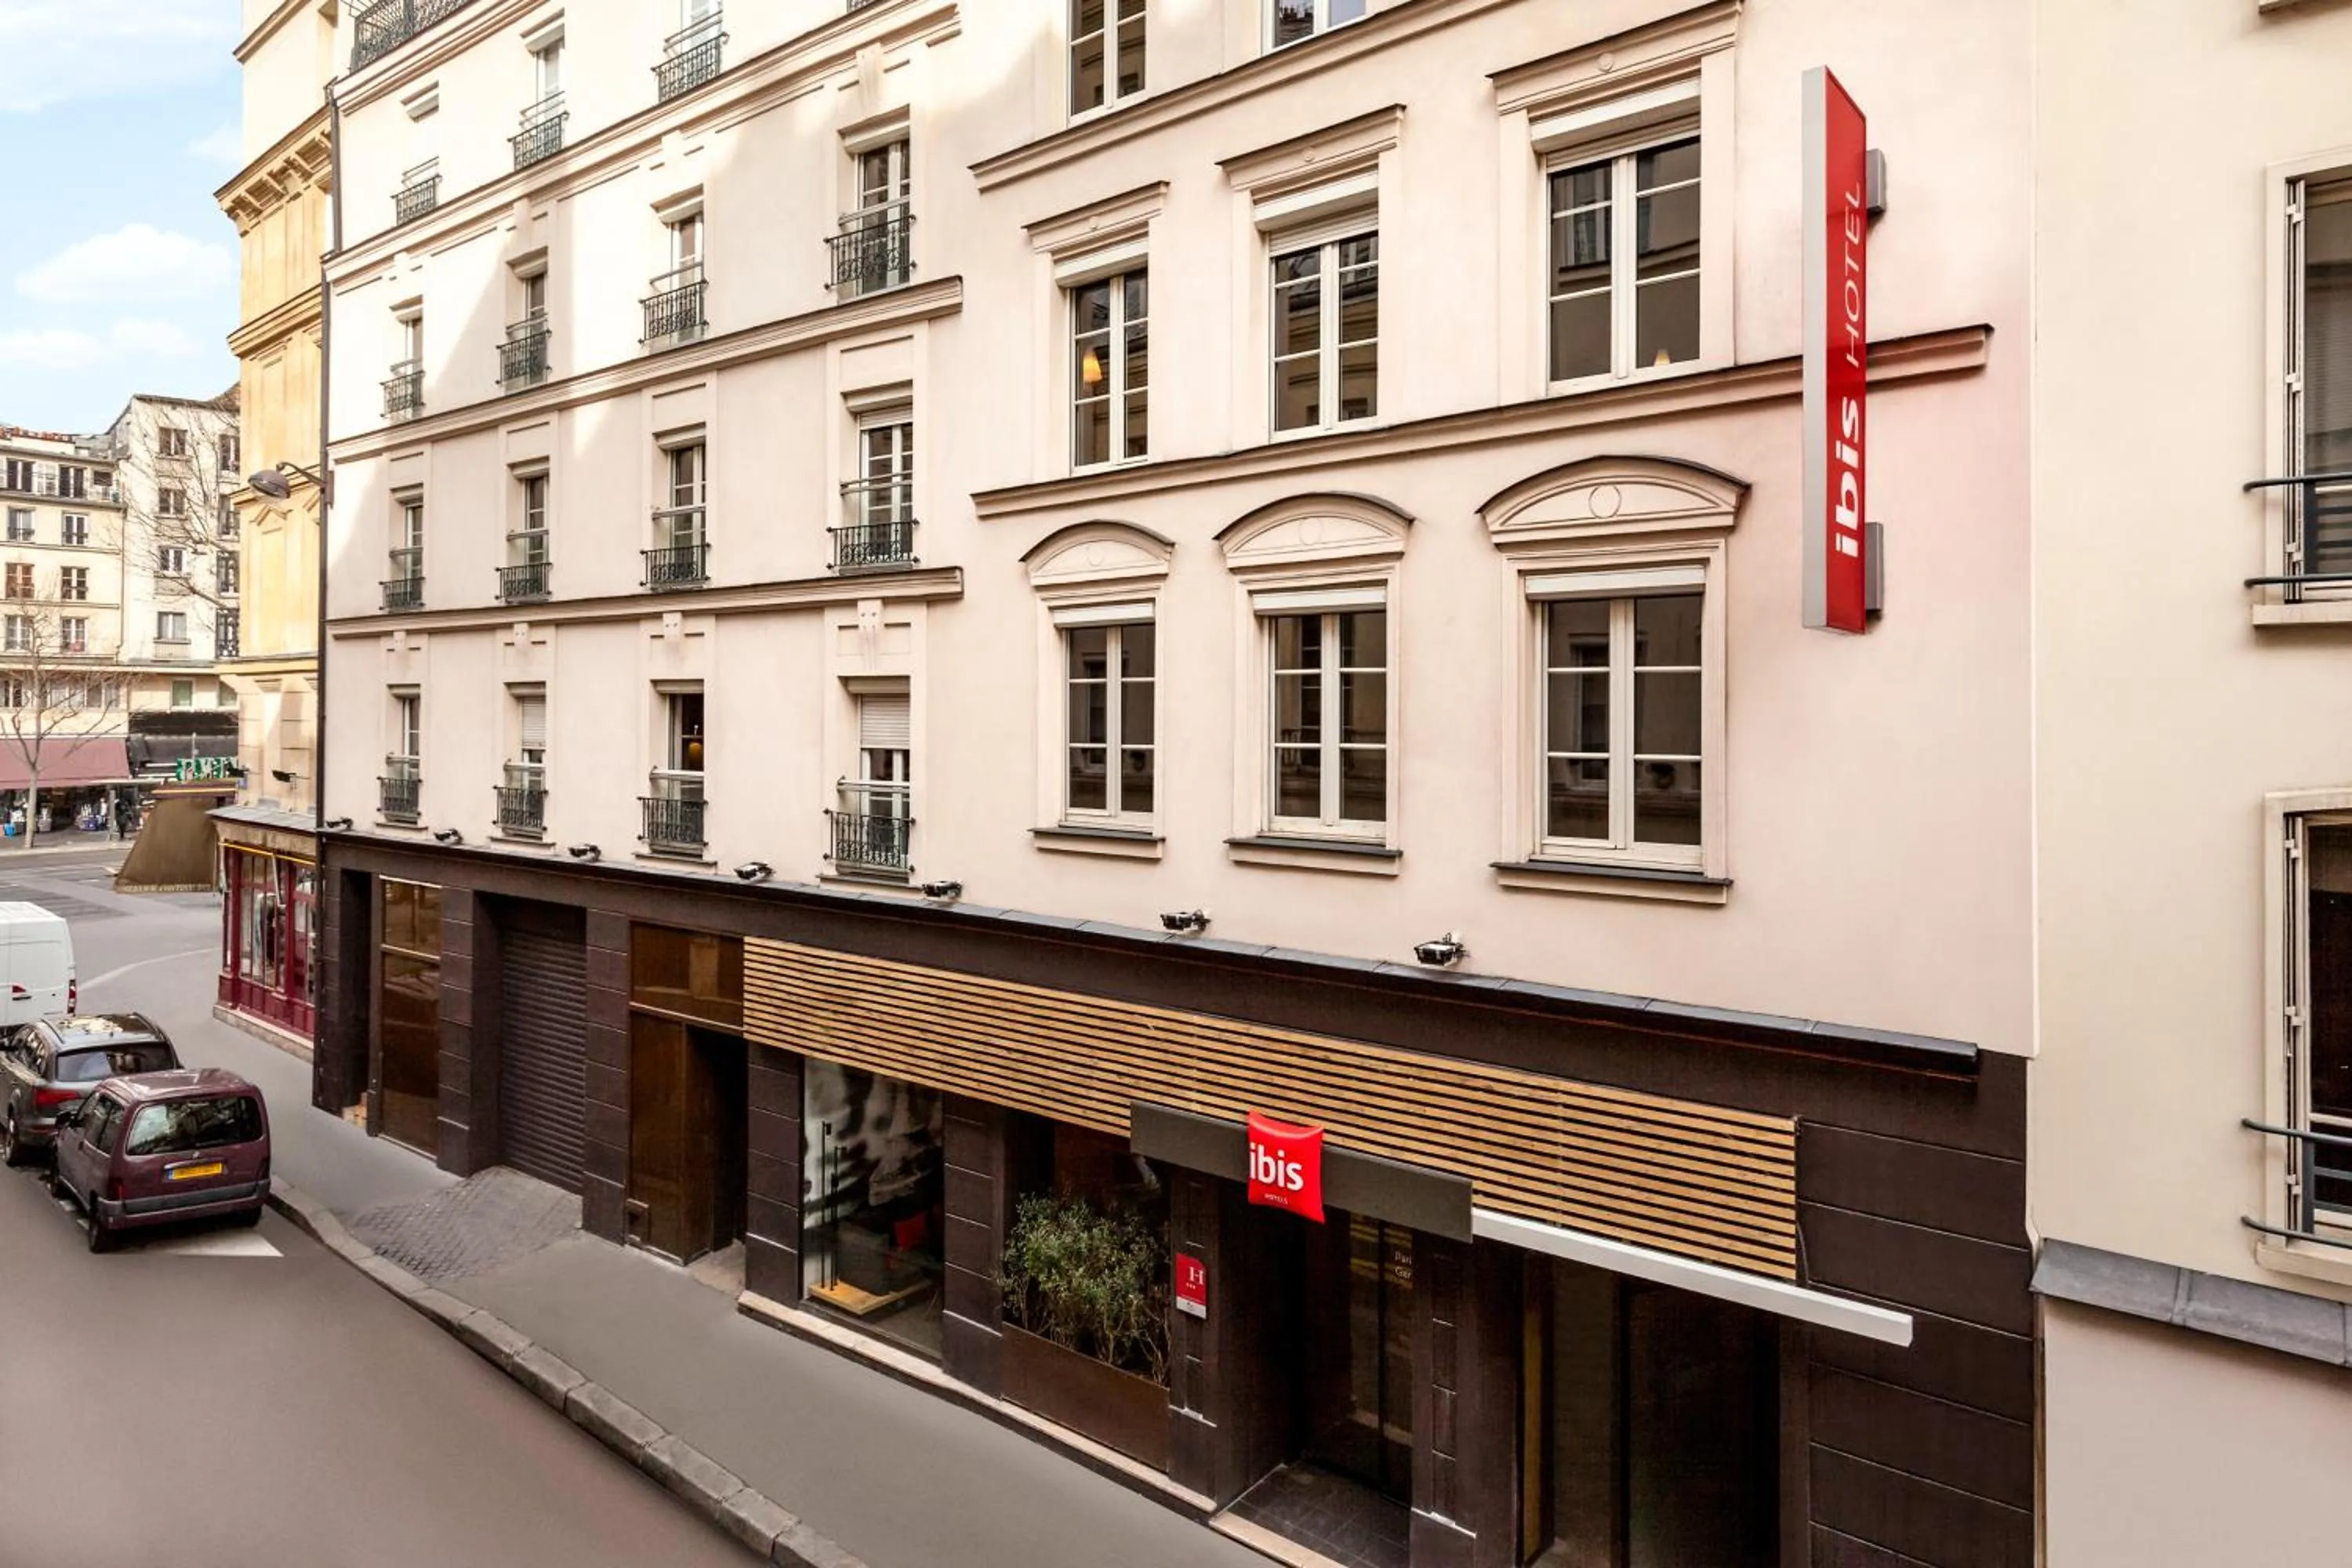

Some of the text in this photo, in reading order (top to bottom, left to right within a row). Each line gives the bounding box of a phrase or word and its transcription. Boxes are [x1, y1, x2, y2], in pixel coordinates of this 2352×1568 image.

[1835, 182, 1861, 558] ibis HOTEL
[1250, 1141, 1304, 1192] ibis
[1188, 1266, 1204, 1285] H
